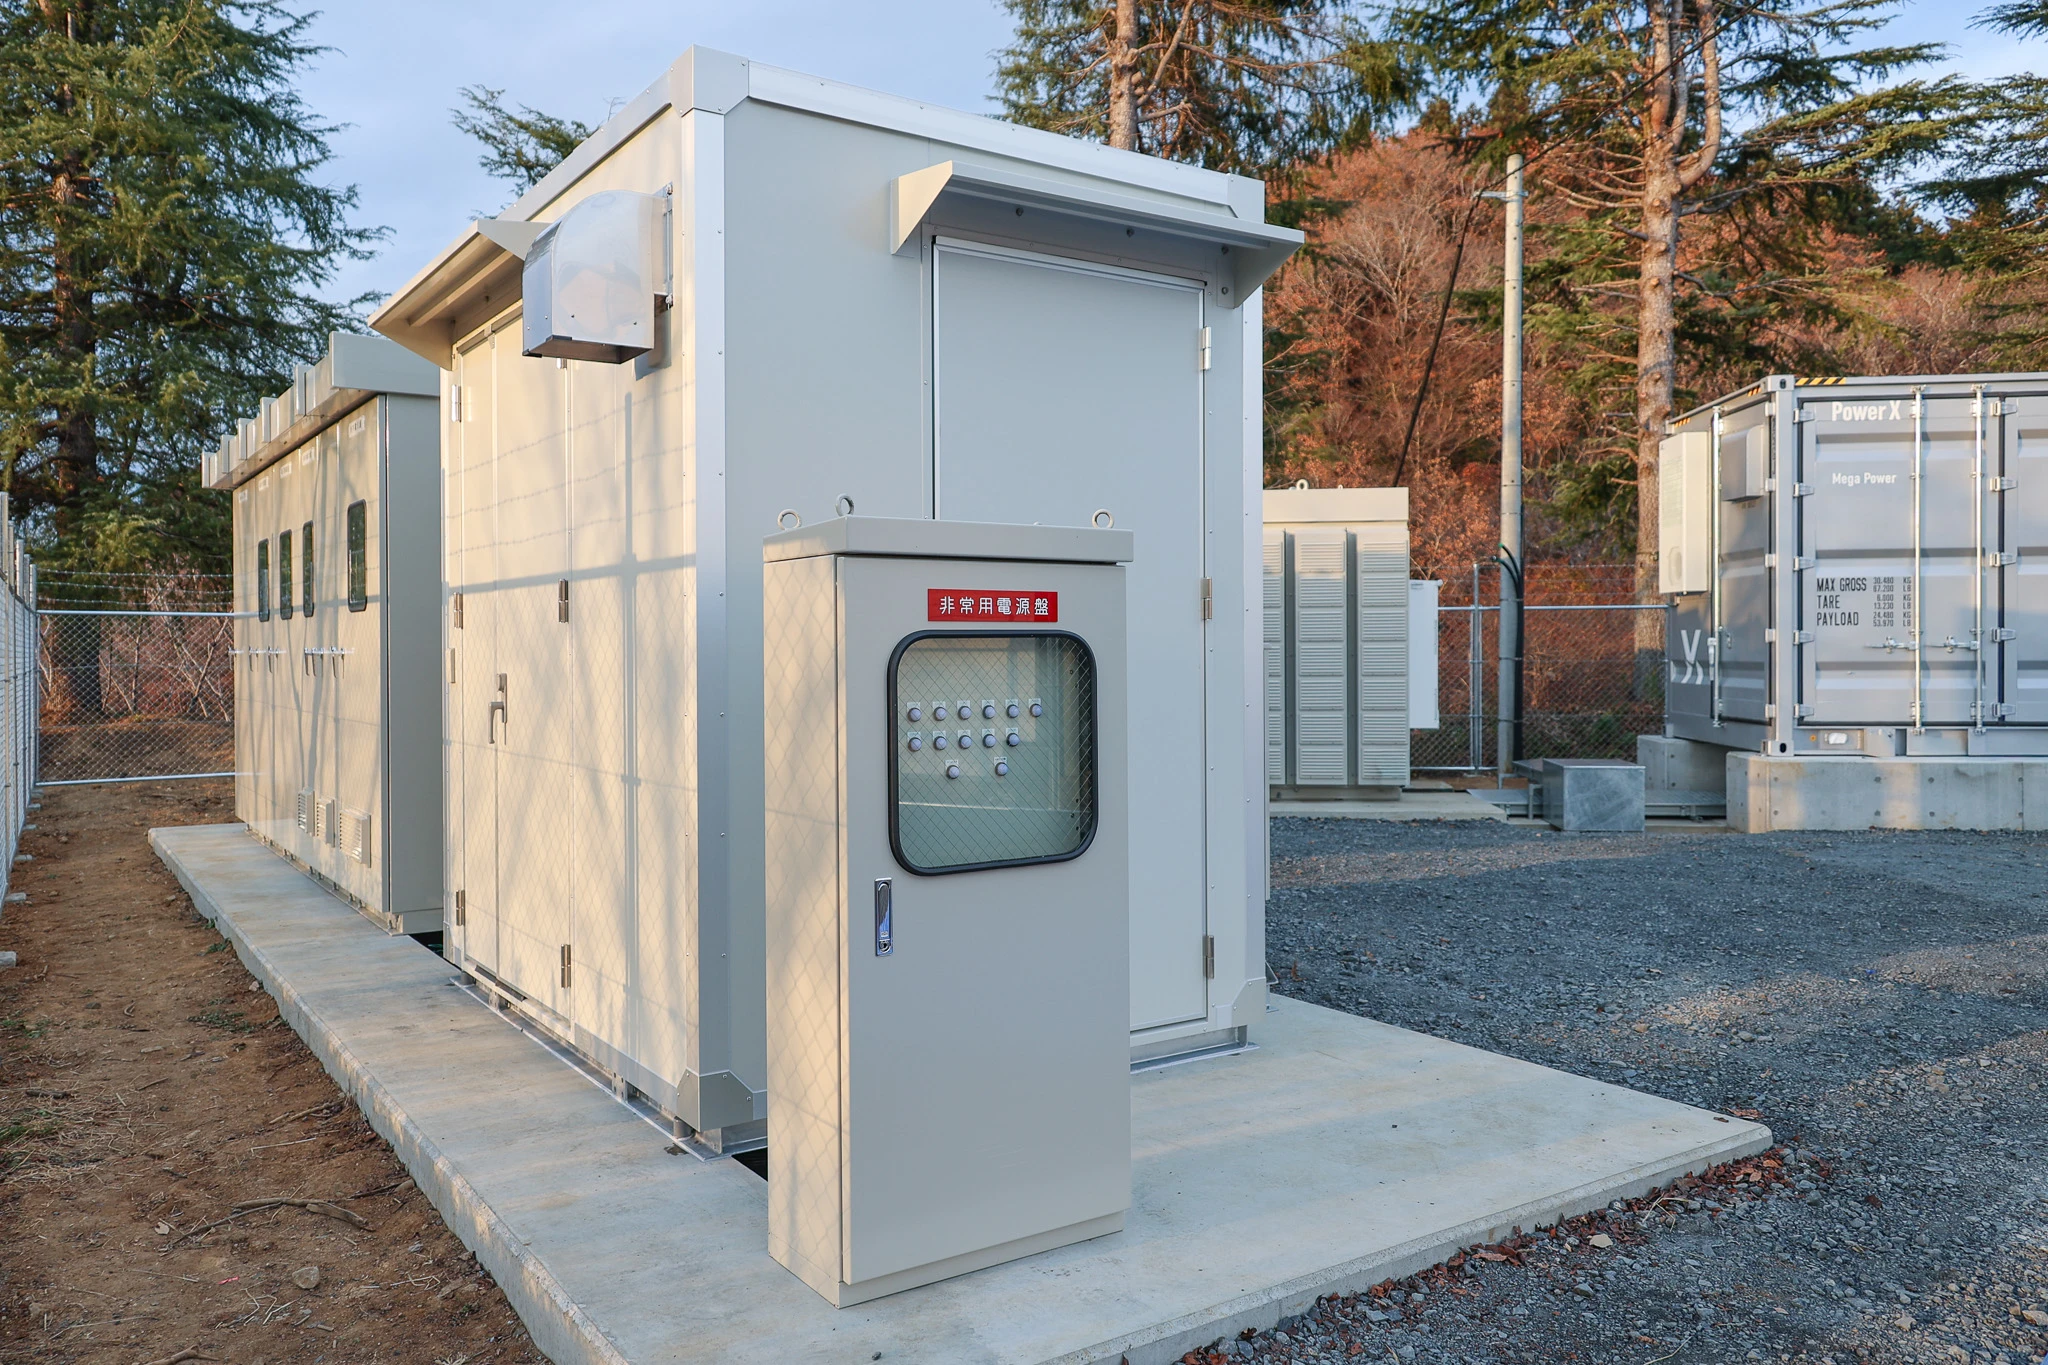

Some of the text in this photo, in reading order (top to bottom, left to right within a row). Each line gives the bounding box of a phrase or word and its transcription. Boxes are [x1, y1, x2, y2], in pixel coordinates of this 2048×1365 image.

[1832, 400, 1901, 421] Power X
[1832, 472, 1897, 487] Mega Power
[1816, 577, 1836, 592] MAX
[1839, 577, 1867, 592] GROSS
[939, 596, 1049, 616] 非常用電源盤
[1817, 595, 1840, 609] TARE
[1903, 594, 1911, 602] KG
[1903, 602, 1911, 610] LB
[1816, 612, 1859, 626] PAYLOAD
[1903, 611, 1911, 619] KG
[1903, 619, 1911, 627] LB
